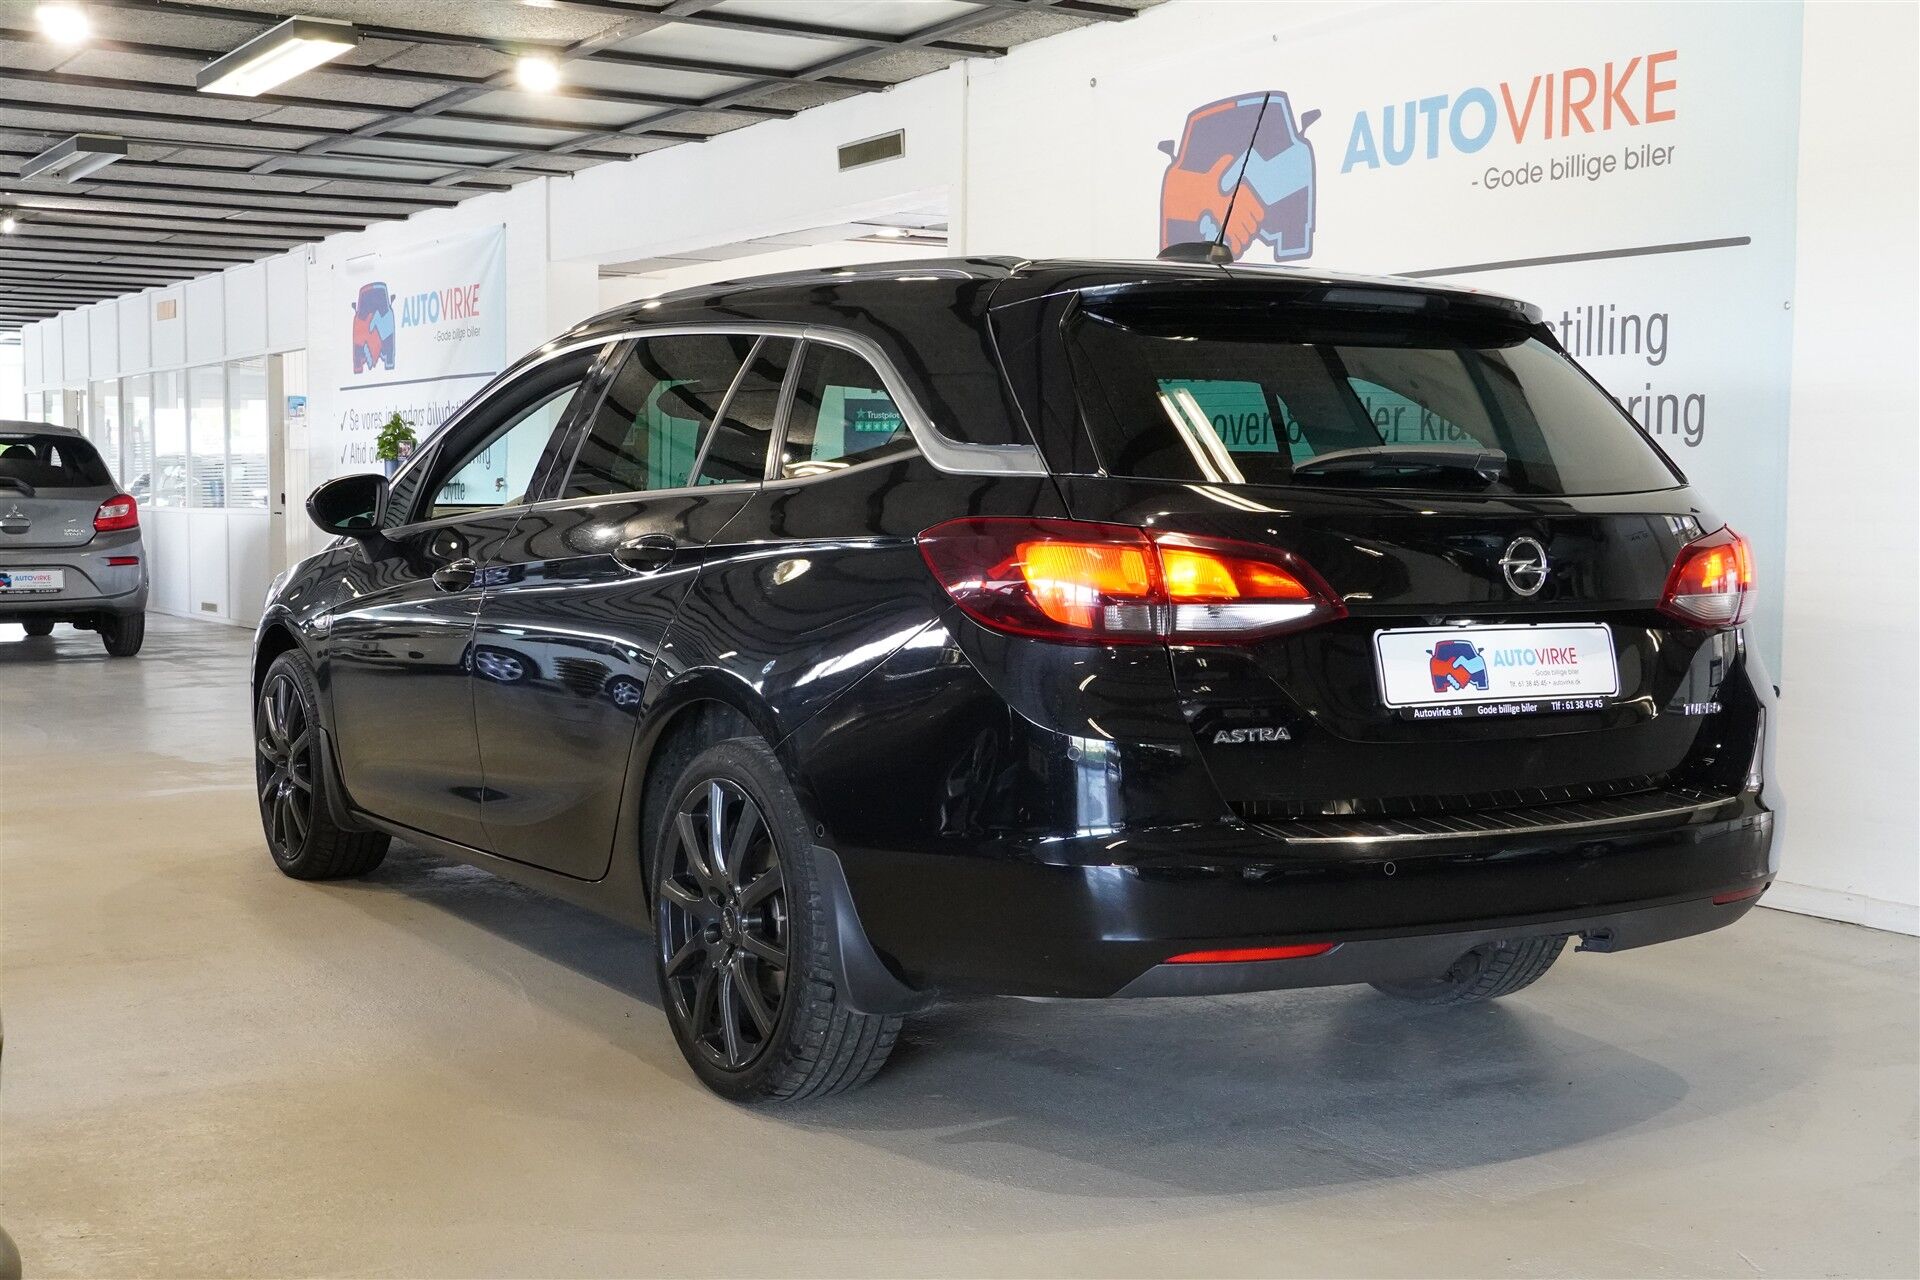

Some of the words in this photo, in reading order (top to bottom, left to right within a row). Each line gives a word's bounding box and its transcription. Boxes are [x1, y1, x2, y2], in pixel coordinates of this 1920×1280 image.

[1340, 50, 1678, 174] AUTOVIRKE
[1483, 163, 1544, 190] Gode
[1550, 154, 1617, 181] billige
[1624, 143, 1675, 171] biler
[401, 284, 480, 328] AUTOVIRKE
[1545, 303, 1669, 367] tilling
[350, 408, 359, 430] Se
[361, 409, 383, 429] vores
[867, 410, 901, 419] Trustpilot
[350, 441, 367, 465] Altid
[15, 574, 52, 582] AUTOVIRKE
[1494, 647, 1578, 667] AUTOVIRKE
[1414, 706, 1451, 718] Autovirke
[1452, 705, 1463, 716] dk
[1477, 705, 1498, 715] Gode
[1498, 703, 1520, 715] billige
[1521, 702, 1538, 713] biler
[1565, 700, 1575, 710] 61
[1575, 700, 1584, 709] 38
[1585, 699, 1594, 709] 45
[1594, 699, 1603, 708] 45
[1213, 727, 1291, 744] ASTRA
